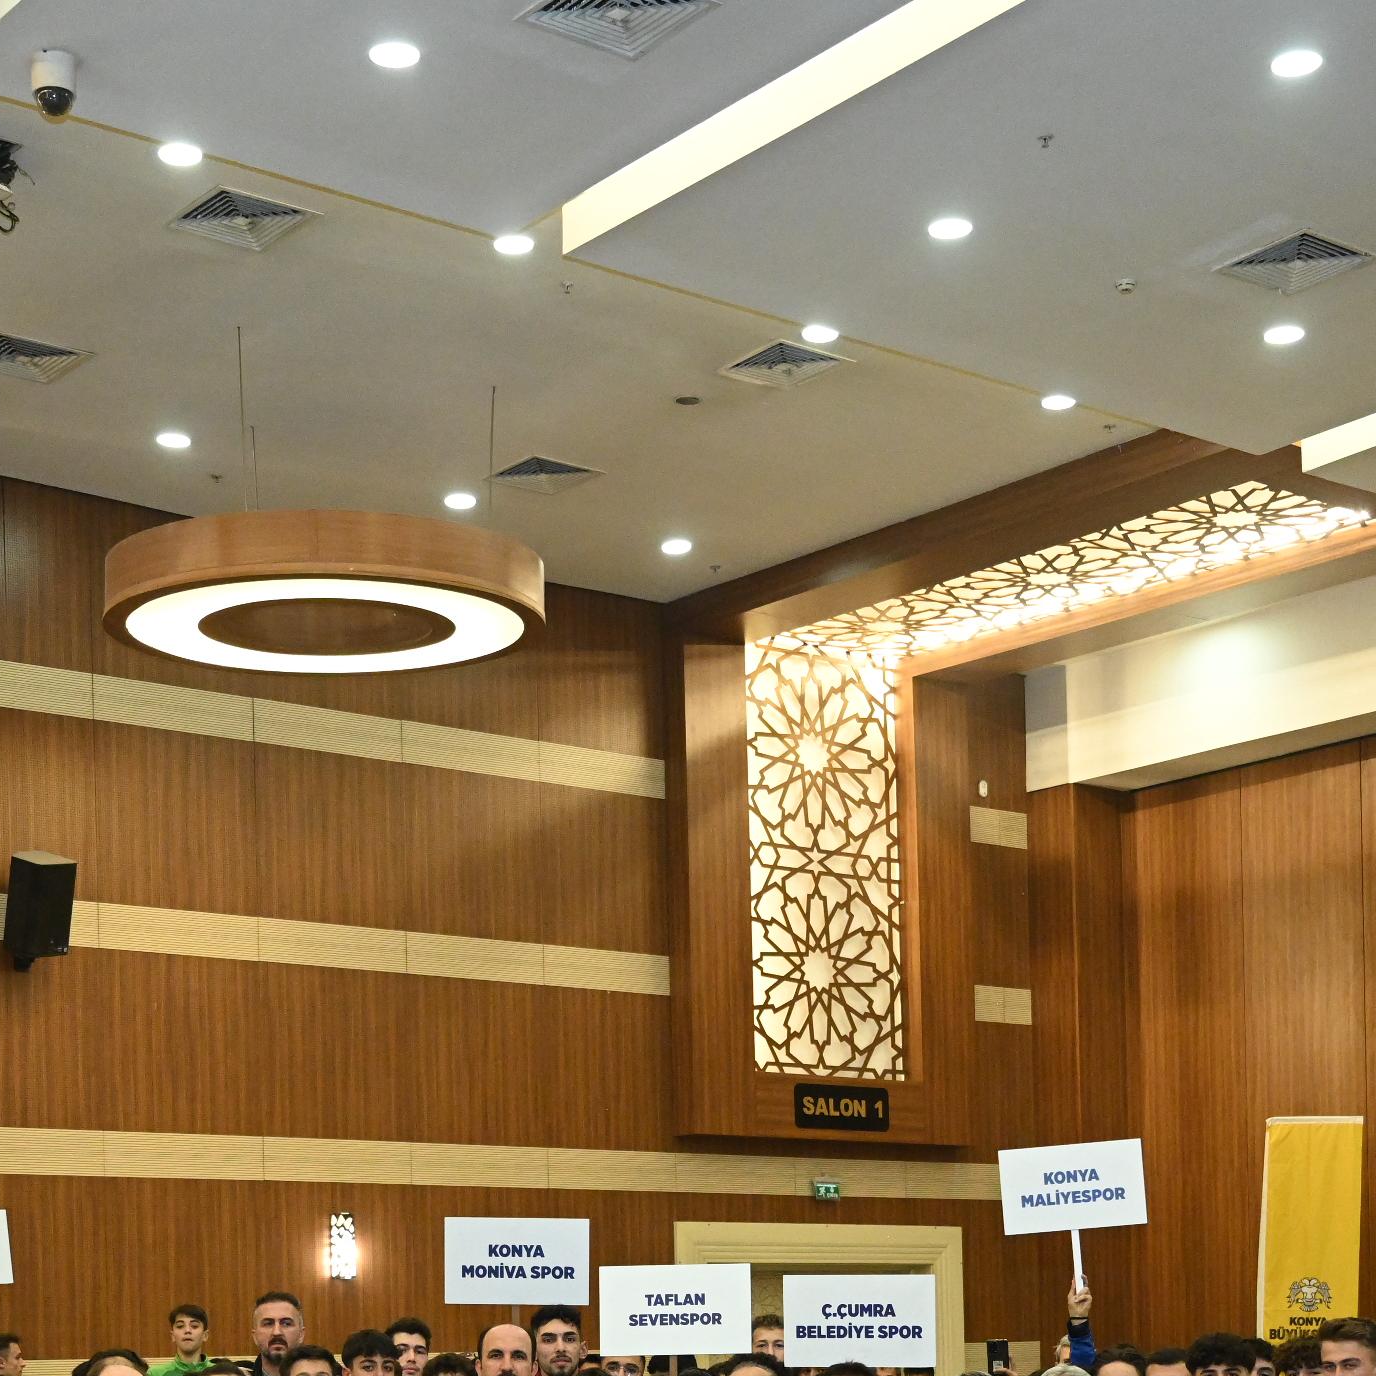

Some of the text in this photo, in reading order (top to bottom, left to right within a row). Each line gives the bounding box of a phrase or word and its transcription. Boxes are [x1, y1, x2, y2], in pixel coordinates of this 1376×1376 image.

[802, 1096, 884, 1119] SALON 1
[1043, 1168, 1100, 1185] KONYA
[1020, 1187, 1126, 1208] MALİYESPOR
[487, 1244, 545, 1258] KONYA
[461, 1262, 576, 1280] MONİVA SPOR
[644, 1293, 707, 1307] TAFLAN
[628, 1312, 722, 1327] SEVENSPOR
[821, 1303, 896, 1320] Ç.ÇUMRA
[795, 1321, 923, 1340] BELEDİYE SPOR
